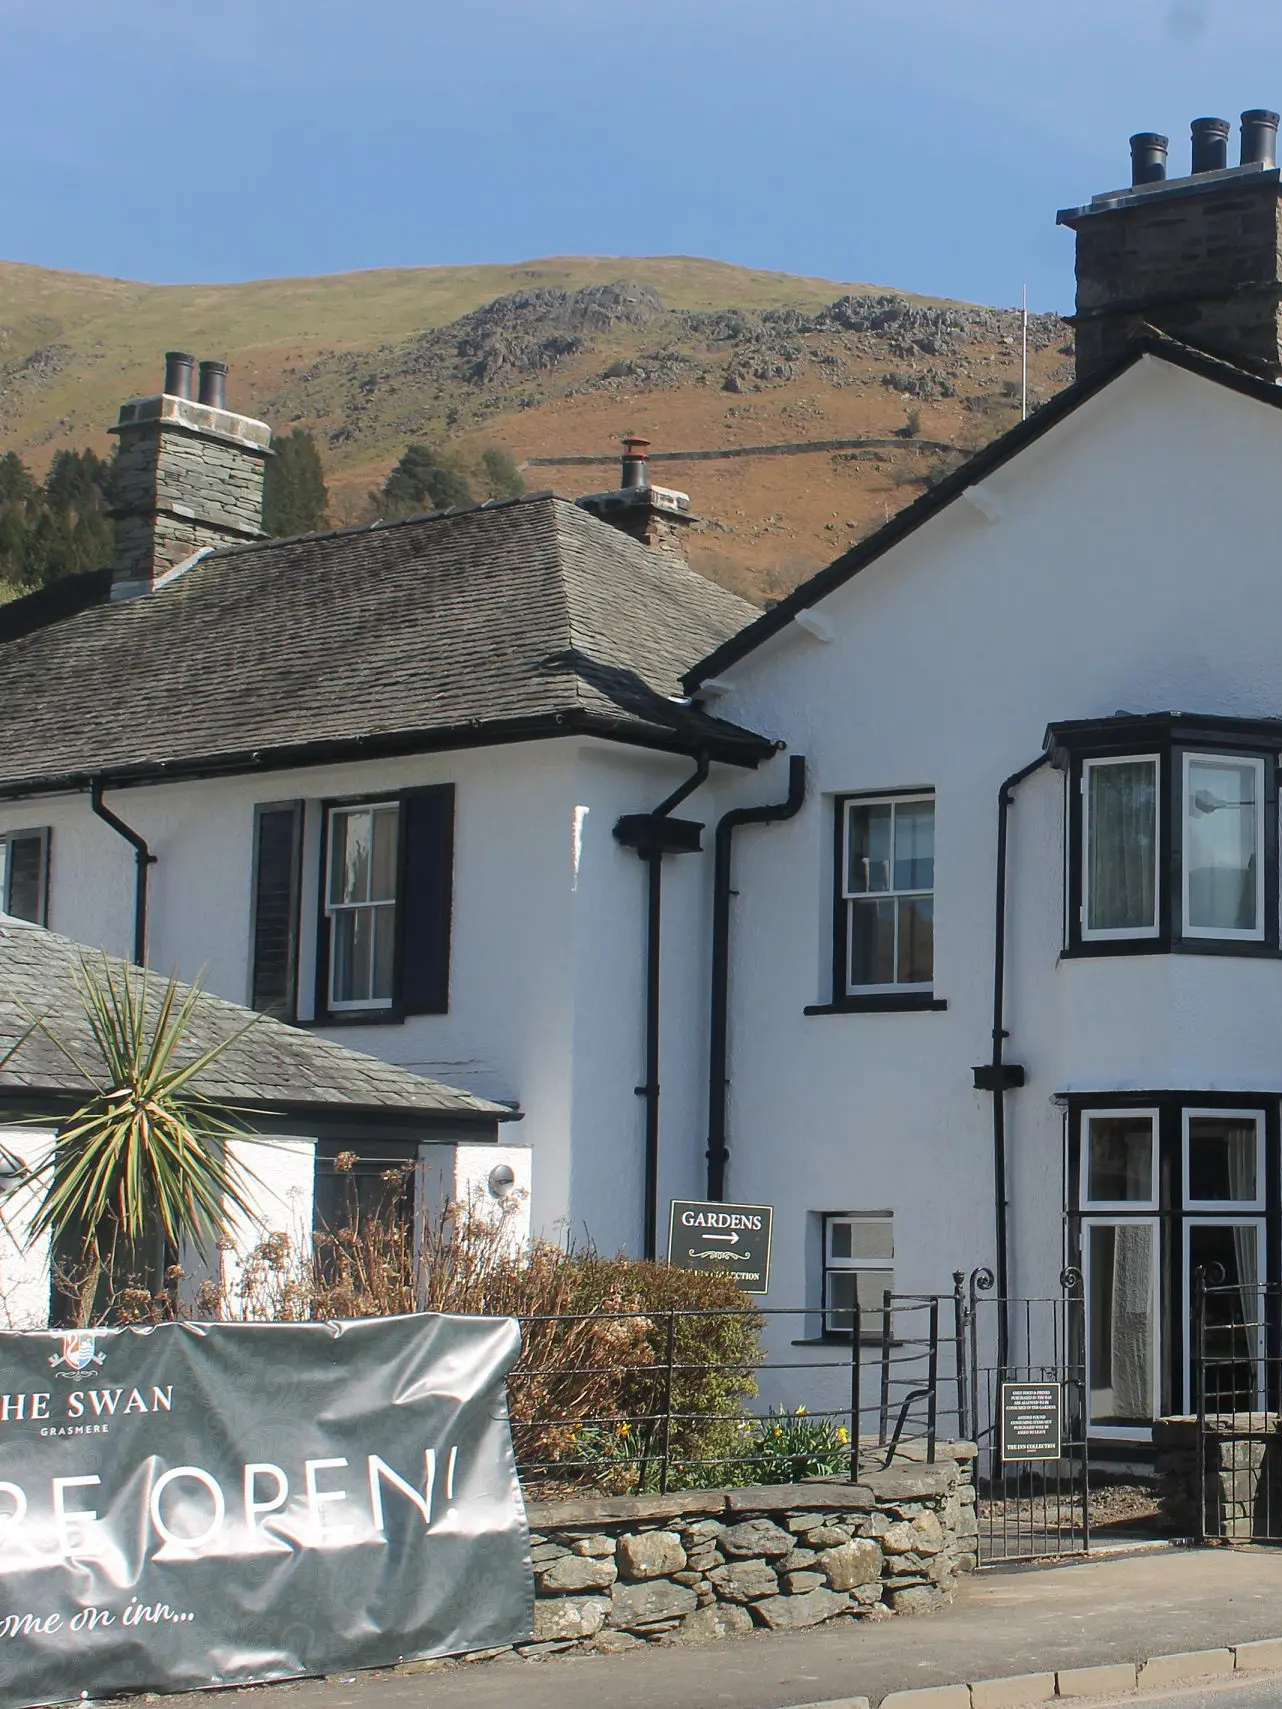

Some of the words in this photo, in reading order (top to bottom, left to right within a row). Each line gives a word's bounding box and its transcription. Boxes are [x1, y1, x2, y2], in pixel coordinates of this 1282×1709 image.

[682, 1211, 762, 1230] GARDENS
[0, 1393, 50, 1421] HE
[68, 1385, 174, 1418] SWAN
[40, 1424, 109, 1436] GRASMERE
[151, 1446, 458, 1547] OPEN!
[70, 1607, 116, 1630] on
